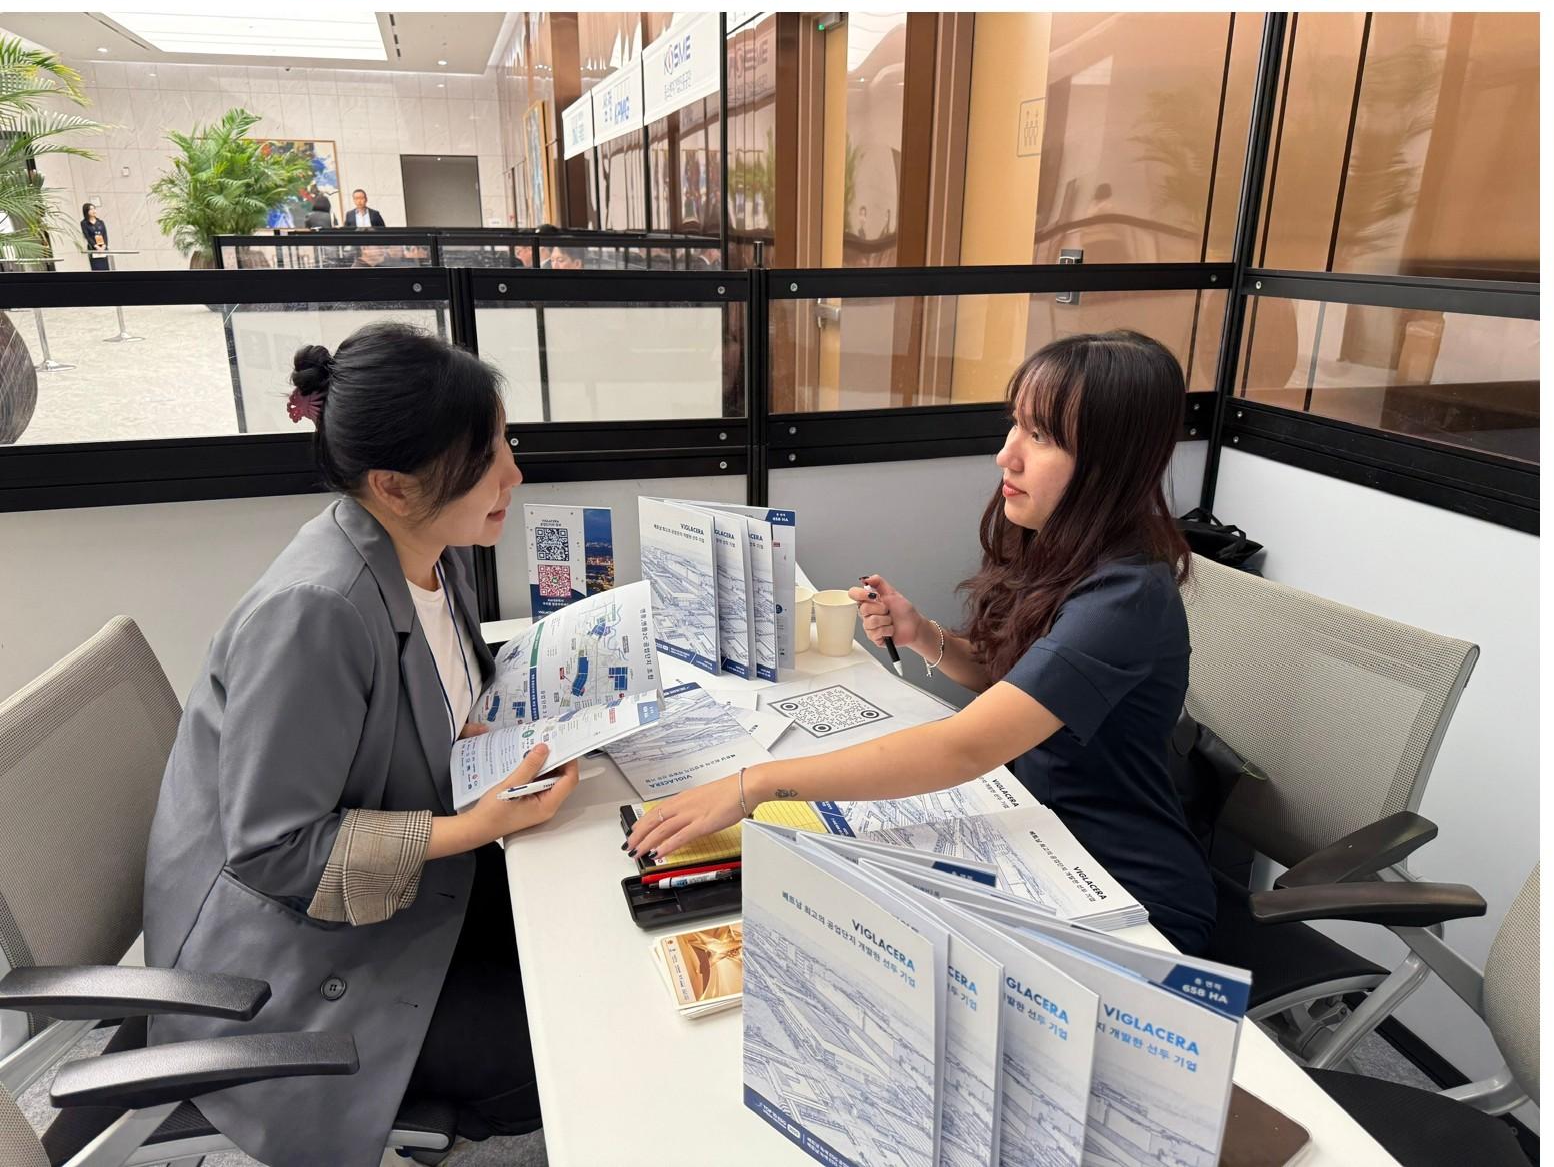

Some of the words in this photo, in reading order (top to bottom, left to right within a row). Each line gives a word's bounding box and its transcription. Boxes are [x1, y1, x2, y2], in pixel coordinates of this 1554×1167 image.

[680, 523, 704, 535] VIGLACERA
[992, 778, 1019, 807] VIGLACERA
[1073, 866, 1107, 900] VIGLACERA
[782, 891, 803, 910] 베트남
[804, 904, 825, 925] 최고의
[826, 919, 856, 945] 공업단지
[858, 938, 880, 963] 개발한
[882, 958, 898, 974] 선두
[899, 972, 916, 989] 기업
[851, 918, 915, 972] VIGLACERA
[961, 994, 977, 1011] 기업
[1004, 993, 1025, 1013] 발한
[1027, 1007, 1047, 1026] 선두
[1049, 1022, 1068, 1041] 기업
[1006, 976, 1069, 1024] GLACERA
[1182, 984, 1206, 998] 658
[1208, 990, 1228, 1004] HA
[1103, 1003, 1200, 1055] VIGLACERA
[1109, 1027, 1143, 1048] 개발한
[1147, 1041, 1171, 1060] 선두
[1173, 1056, 1197, 1073] 기업
